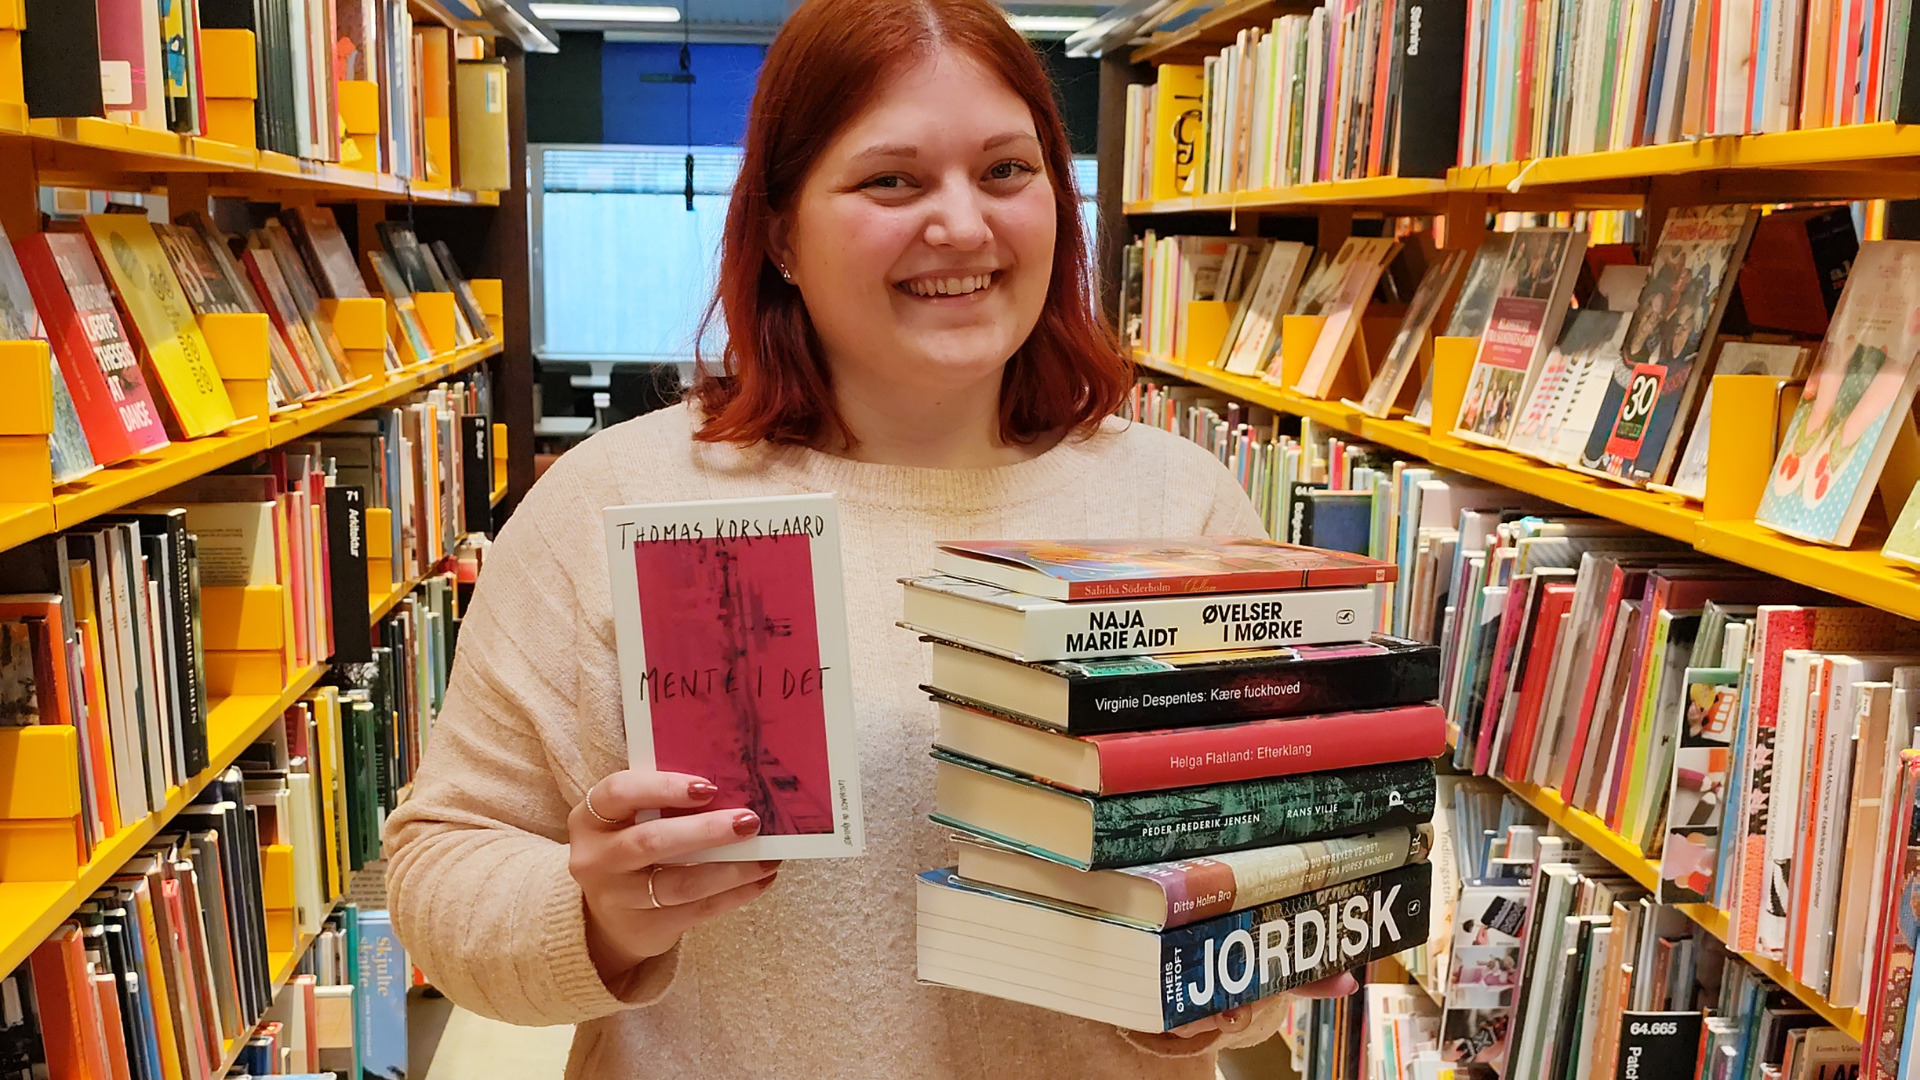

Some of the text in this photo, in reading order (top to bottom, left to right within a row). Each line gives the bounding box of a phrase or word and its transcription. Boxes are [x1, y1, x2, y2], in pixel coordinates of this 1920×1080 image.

[94, 342, 136, 372] THESEUS
[108, 375, 126, 403] AT
[1623, 375, 1657, 421] 30
[119, 401, 153, 433] DANSE
[346, 491, 358, 502] 71
[349, 508, 361, 557] Arkitektur
[616, 515, 824, 549] THOMAS KORSGAARD
[1084, 583, 1120, 596] Sabitha
[1121, 581, 1171, 595] Söderholm
[1090, 609, 1144, 631] NAJA
[1202, 601, 1283, 625] ØVELSER
[1066, 627, 1178, 653] MARIE AIDT
[1223, 619, 1303, 642] I MØRKE
[640, 665, 831, 702] MENTE I DET
[1095, 681, 1301, 715] Virginie Despentes: Kære fuckhoved
[1170, 743, 1312, 771] Helga Flatland: Efterklang
[1828, 733, 1838, 772] Vanessa
[1286, 802, 1338, 818] RANS VILJE
[1142, 813, 1260, 837] PEDER FREDERIK JENSEN
[1310, 858, 1320, 869] DU
[1327, 866, 1341, 878] FRA
[1343, 860, 1362, 875] VORES
[1362, 852, 1394, 870] KNOGLER
[1173, 890, 1232, 914] Ditte Holm Bro
[1188, 884, 1402, 1006] JORDISK
[372, 936, 393, 997] Skjulte
[1175, 947, 1184, 1012] ØRNTOFT
[1630, 1022, 1677, 1036] 64.665
